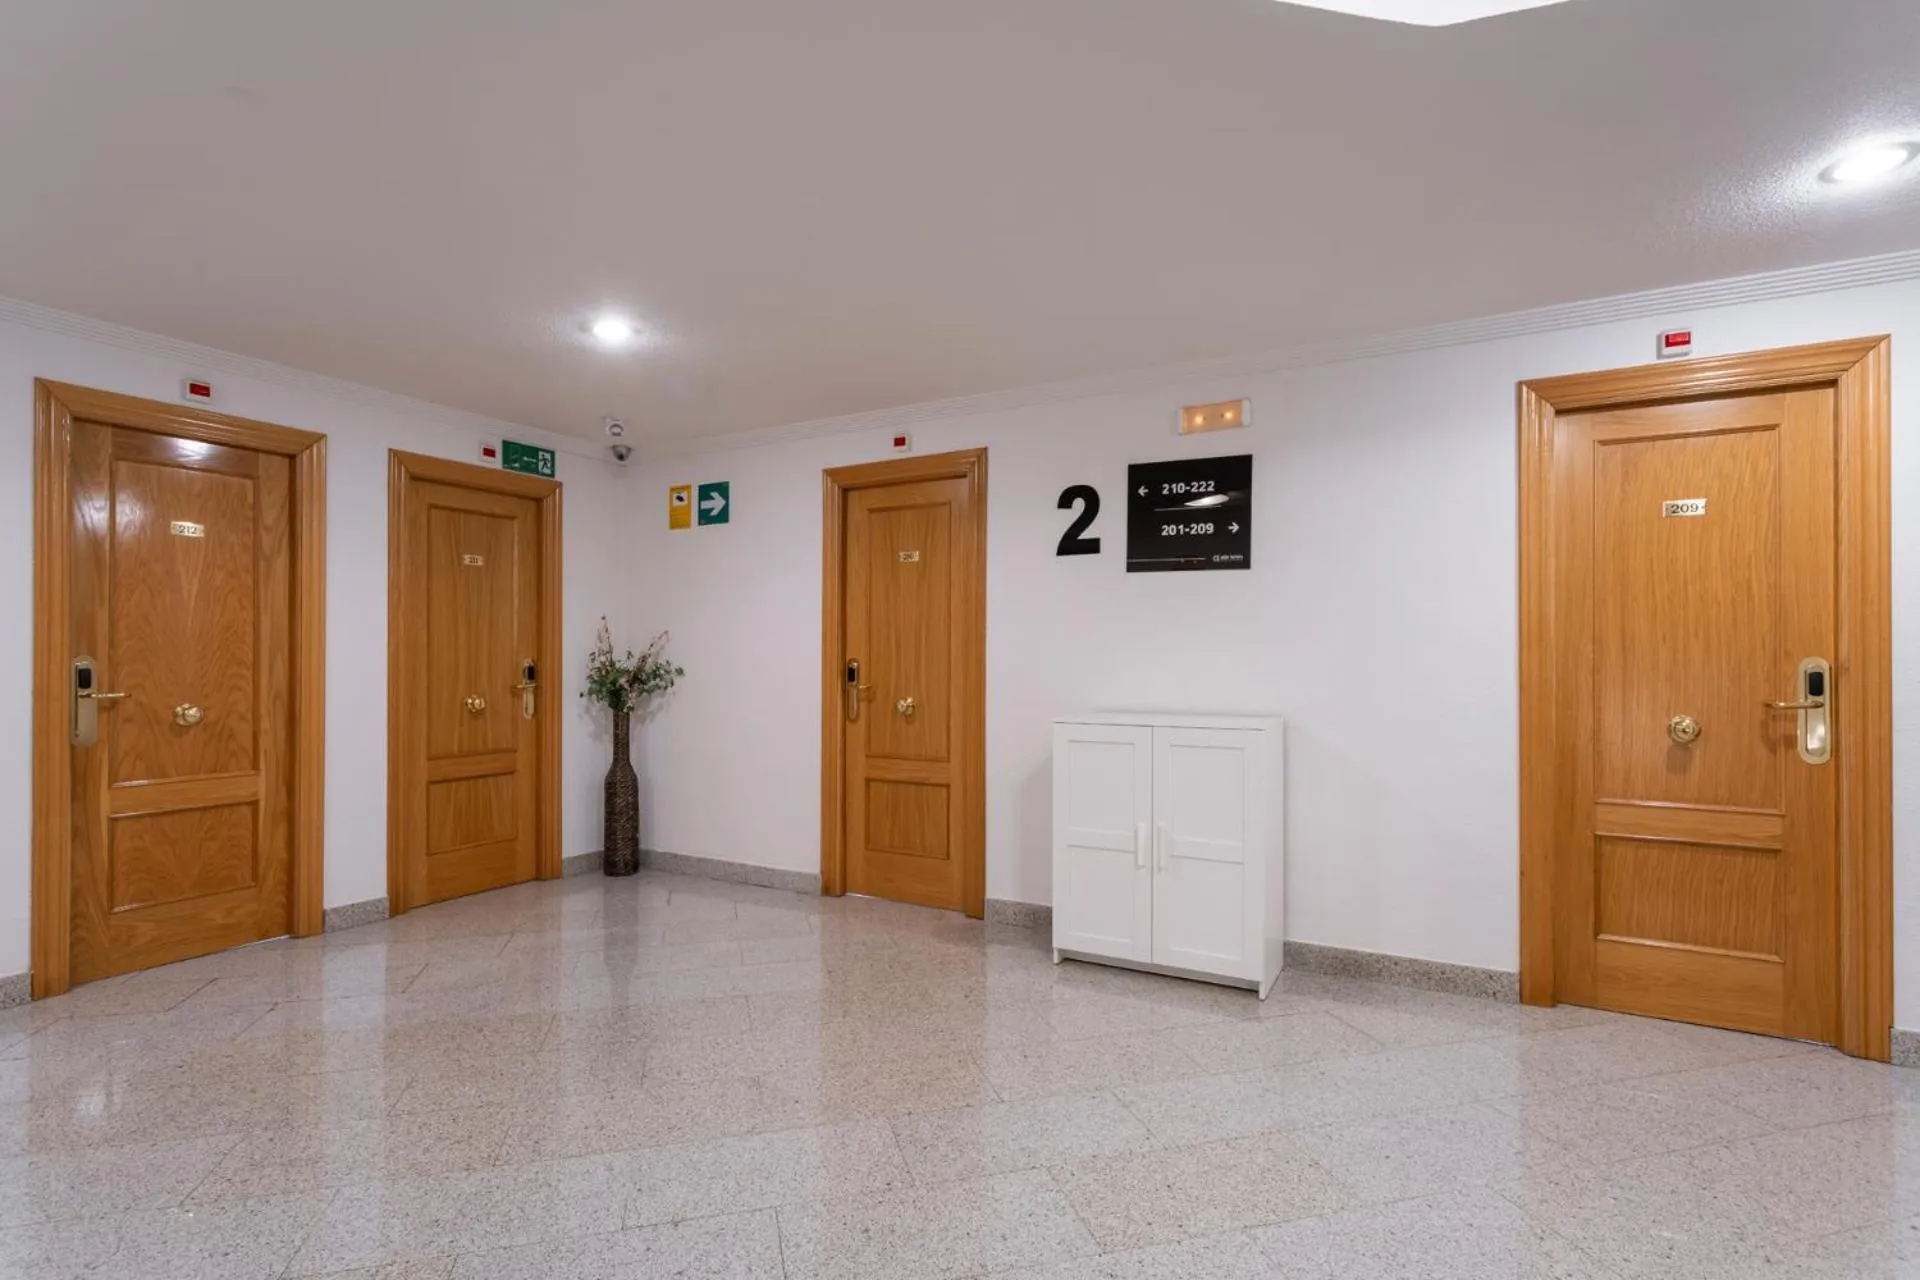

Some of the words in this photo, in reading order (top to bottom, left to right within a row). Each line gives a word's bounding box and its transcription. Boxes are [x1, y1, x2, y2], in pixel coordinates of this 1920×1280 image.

[1161, 481, 1215, 495] 210-222
[1671, 503, 1699, 514] 209
[1056, 484, 1101, 556] 2
[1161, 523, 1214, 536] 201-209
